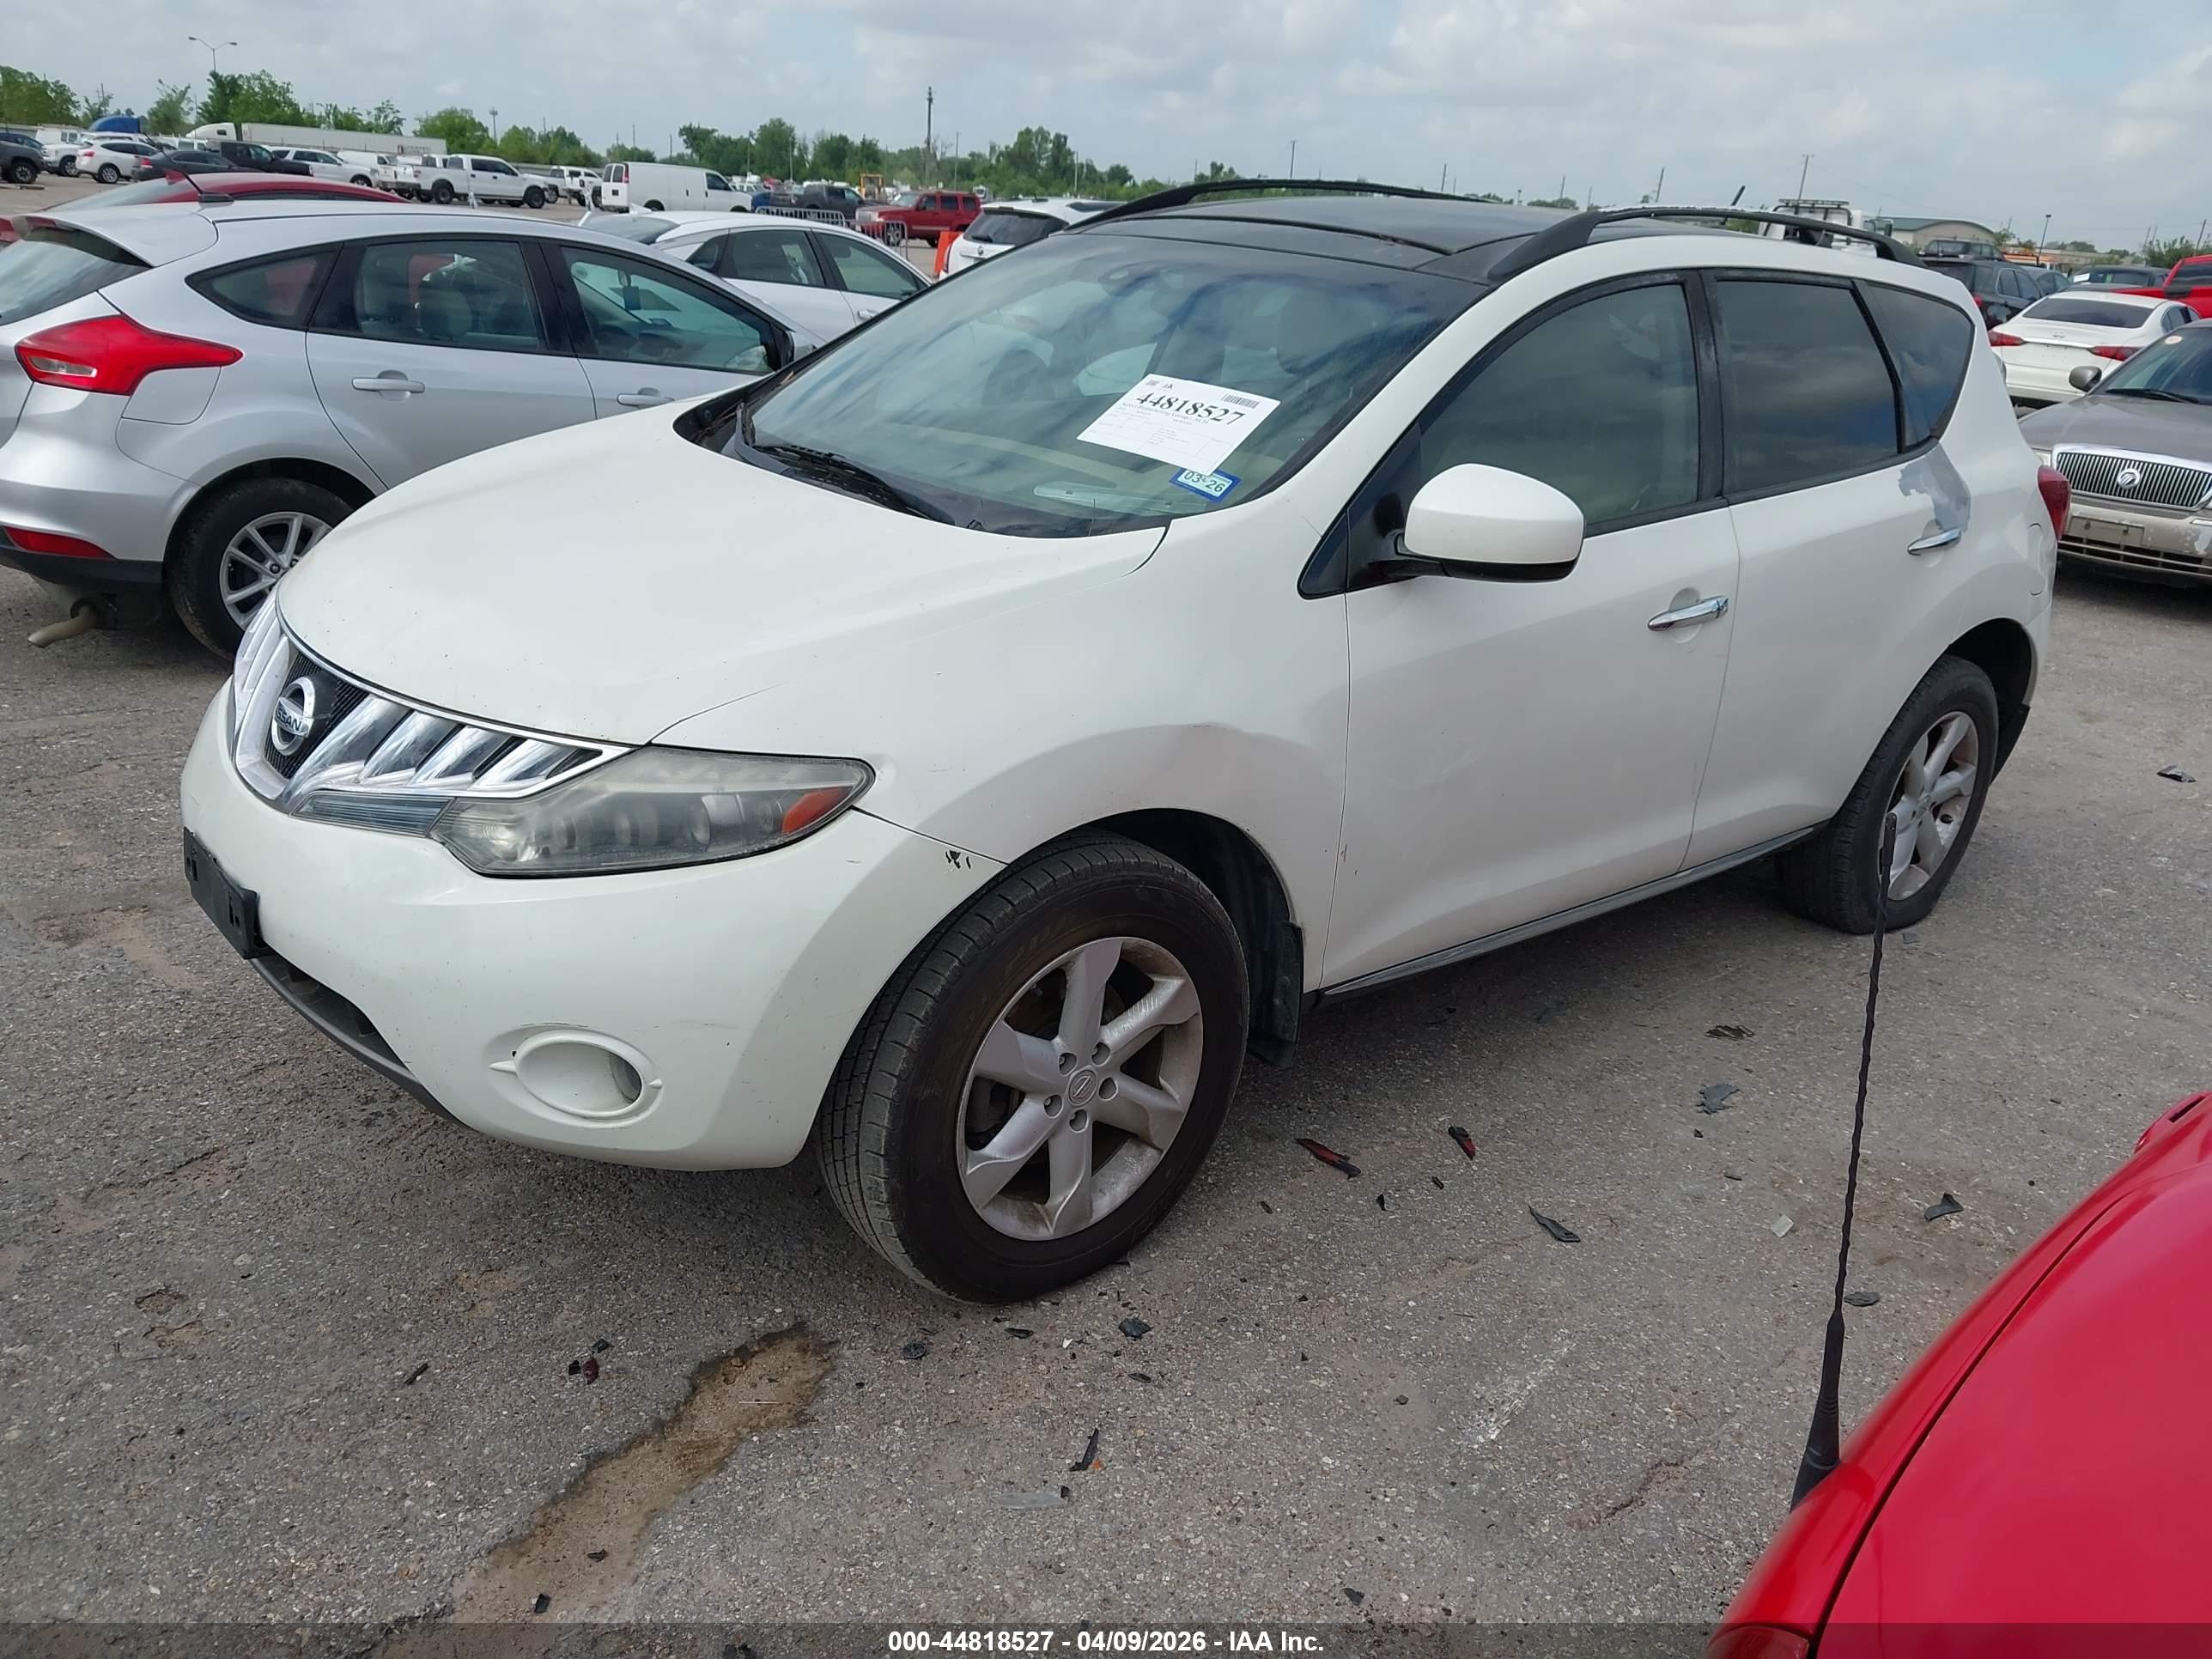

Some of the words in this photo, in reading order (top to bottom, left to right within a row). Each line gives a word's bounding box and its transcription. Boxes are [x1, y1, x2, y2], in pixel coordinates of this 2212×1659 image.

[1136, 392, 1246, 425] 44818527
[1184, 471, 1202, 483] 03
[1205, 480, 1225, 493] 26
[275, 707, 302, 732] SSAN
